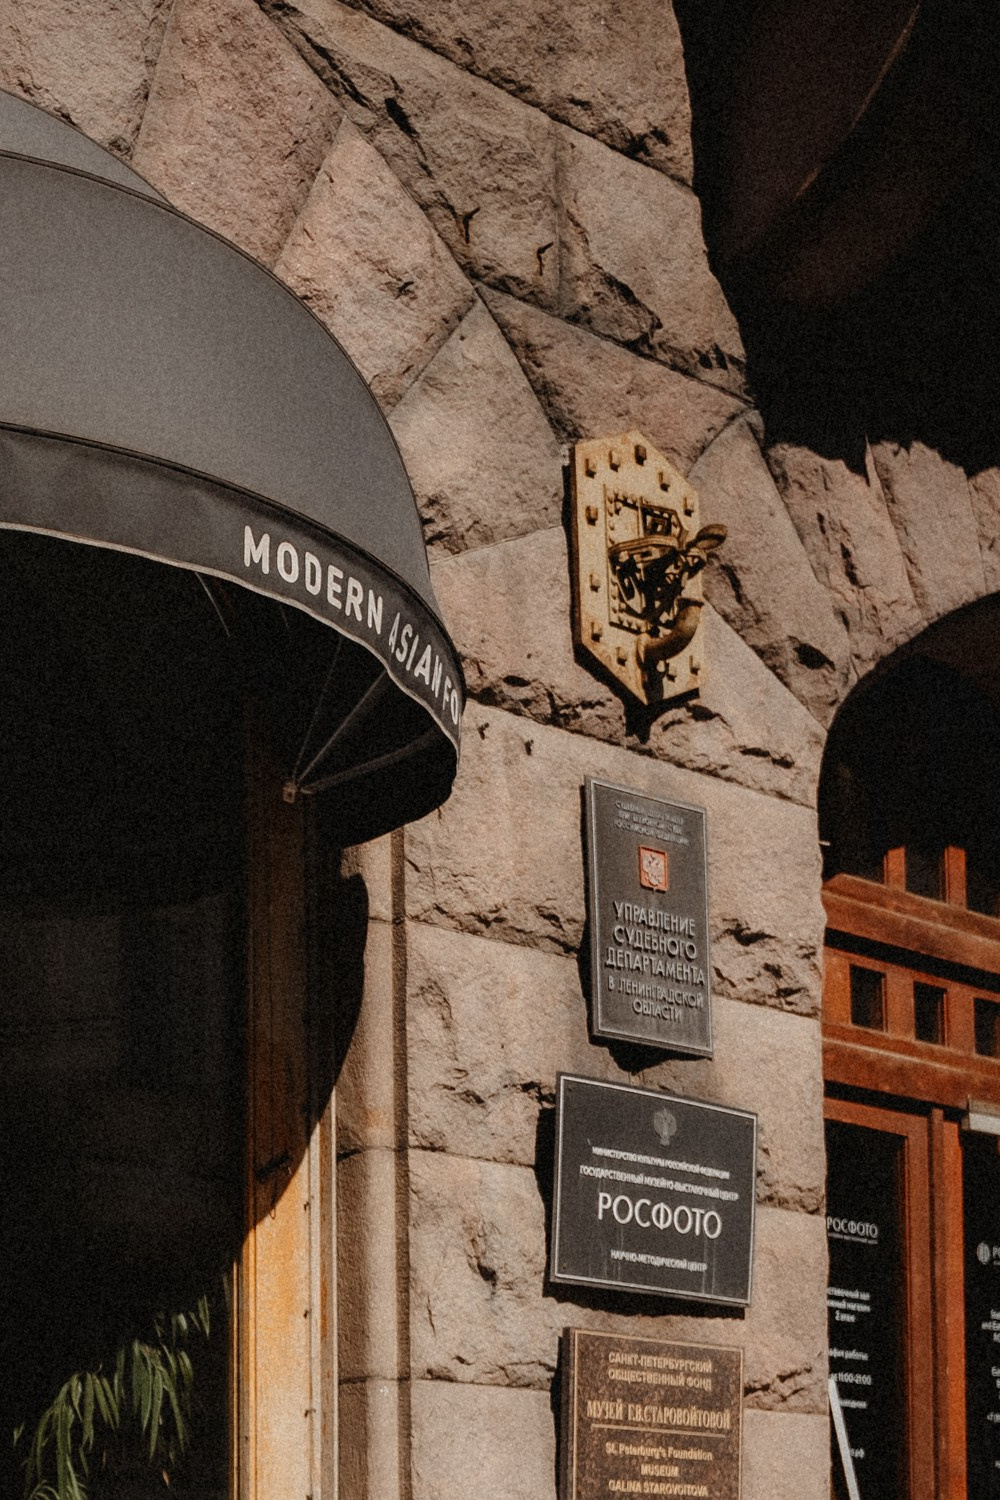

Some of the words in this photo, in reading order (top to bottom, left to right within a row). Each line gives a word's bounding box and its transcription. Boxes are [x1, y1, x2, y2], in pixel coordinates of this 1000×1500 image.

[244, 525, 383, 635] MODERN
[388, 611, 443, 698] ASIAN
[612, 900, 697, 937] УПРАВЛЕНИЕ
[614, 924, 698, 960] СУДЕБНОГО
[605, 946, 705, 985] ДЕПАРТАМЕНТА
[607, 975, 616, 990] В
[619, 978, 704, 1008] ЛЕНИНГРАДСКОЙ
[632, 998, 682, 1021] ОБЛАСТИ
[598, 1192, 722, 1239] РОСФОТО
[827, 1215, 879, 1239] РОСФОТО
[608, 1351, 712, 1373] САНКТ-ПЕТЕРБУРГСКИЙ
[608, 1368, 685, 1387] ОБЩЕСТВЕННЫЙ
[686, 1377, 712, 1391] ФОНД
[586, 1398, 624, 1421] МУЗЕЙ
[668, 1446, 713, 1461] Foundation
[640, 1463, 679, 1477] MUSEUM
[608, 1479, 642, 1493] GALINA
[643, 1481, 709, 1497] STAROVOITOVA
